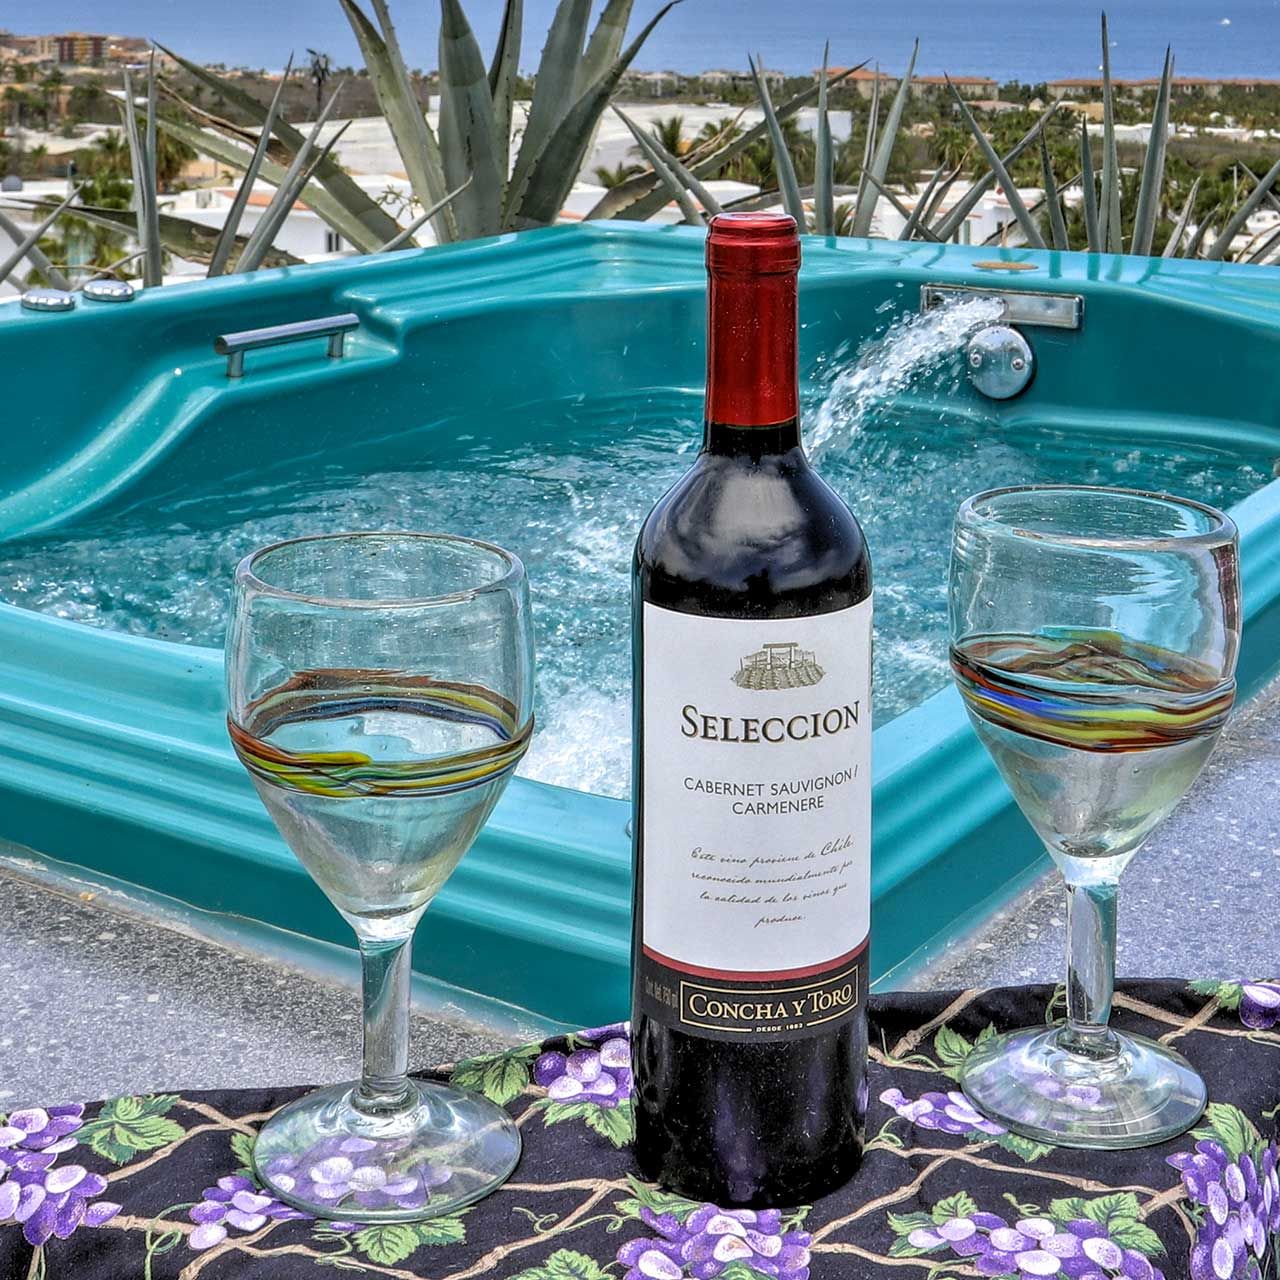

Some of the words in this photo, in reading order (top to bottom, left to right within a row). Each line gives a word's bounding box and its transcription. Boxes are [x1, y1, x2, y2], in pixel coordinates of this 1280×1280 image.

[681, 700, 860, 743] SELECCION
[684, 777, 765, 796] CABERNET
[732, 795, 824, 815] CARMENERE
[720, 854, 747, 864] vino
[749, 854, 800, 868] proviene
[803, 851, 817, 860] de
[691, 871, 752, 884] reconocido
[755, 865, 839, 884] mundialmente
[700, 891, 712, 900] la
[714, 894, 761, 904] calidad
[764, 895, 778, 904] de
[782, 892, 798, 903] los
[802, 889, 830, 900] vinos
[689, 993, 789, 1021] CONCHA
[791, 1000, 806, 1016] Y
[807, 983, 853, 1013] TORO
